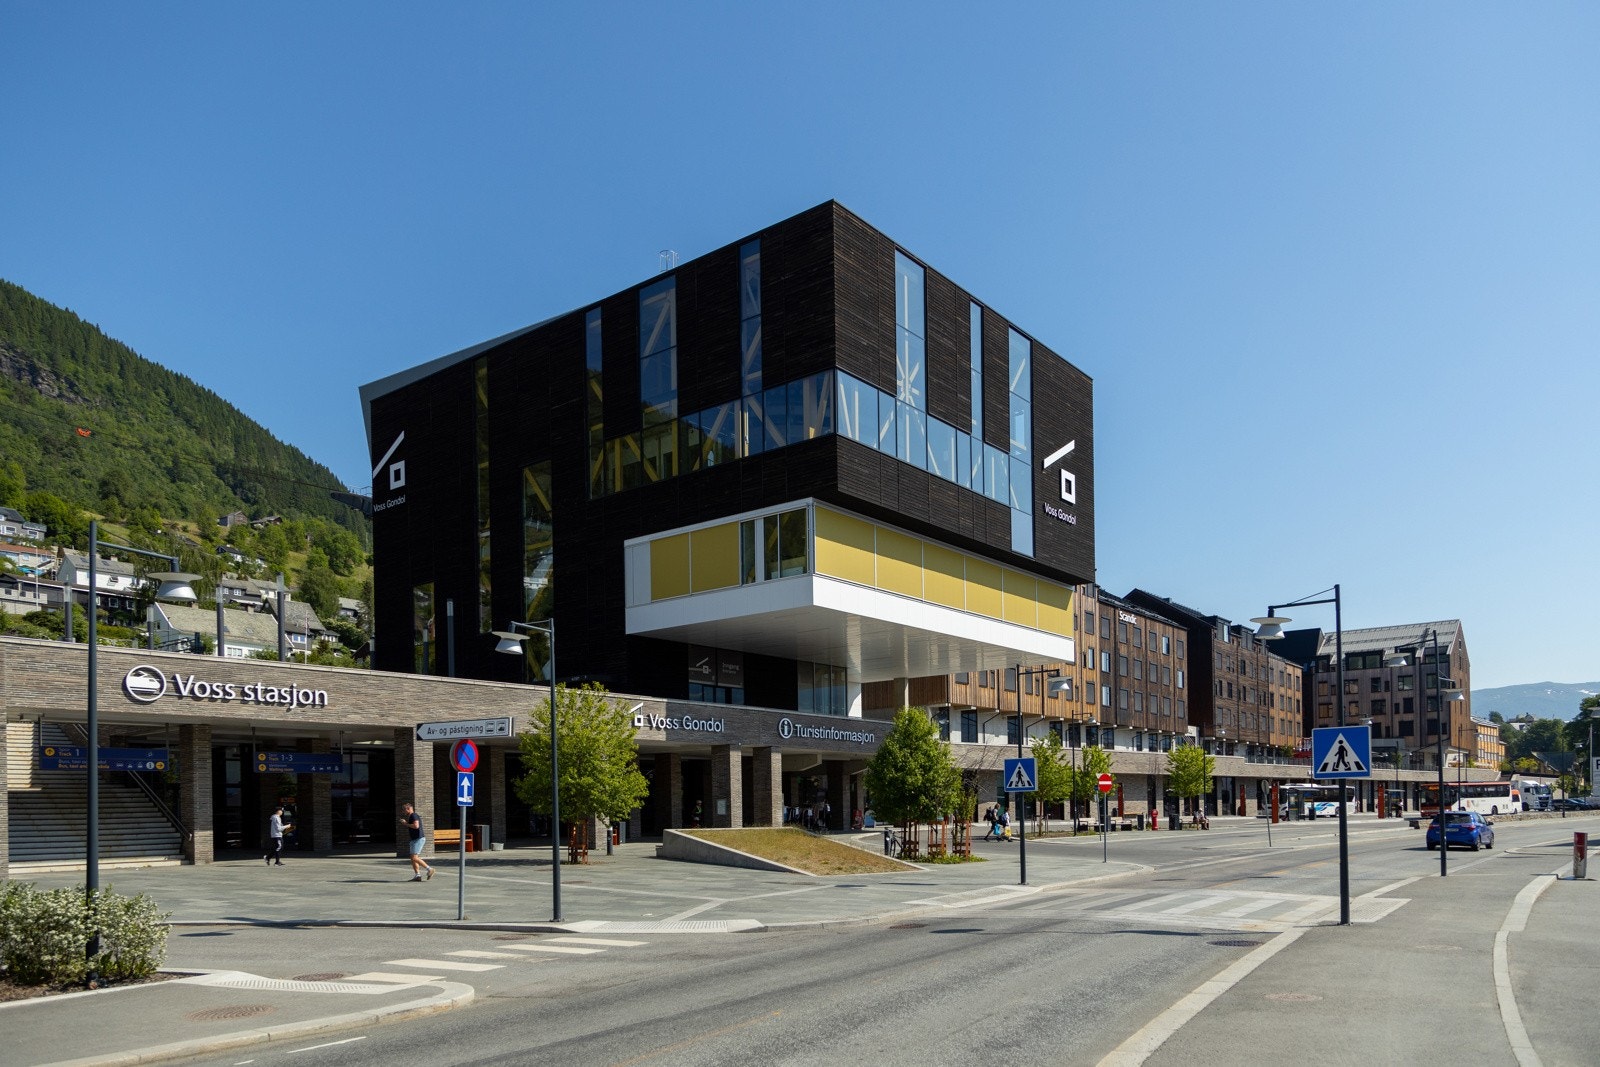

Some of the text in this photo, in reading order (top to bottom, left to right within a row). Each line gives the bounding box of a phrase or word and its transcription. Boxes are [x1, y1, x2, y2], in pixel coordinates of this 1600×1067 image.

[373, 494, 406, 512] Voss Gondol
[1044, 502, 1077, 525] Voss Gondol
[1119, 610, 1137, 624] Scandic
[174, 673, 328, 709] Voss stasjon
[427, 724, 484, 736] Av- og påstigning
[649, 713, 725, 733] Voss Gondol
[794, 723, 875, 745] Turistinformasjon
